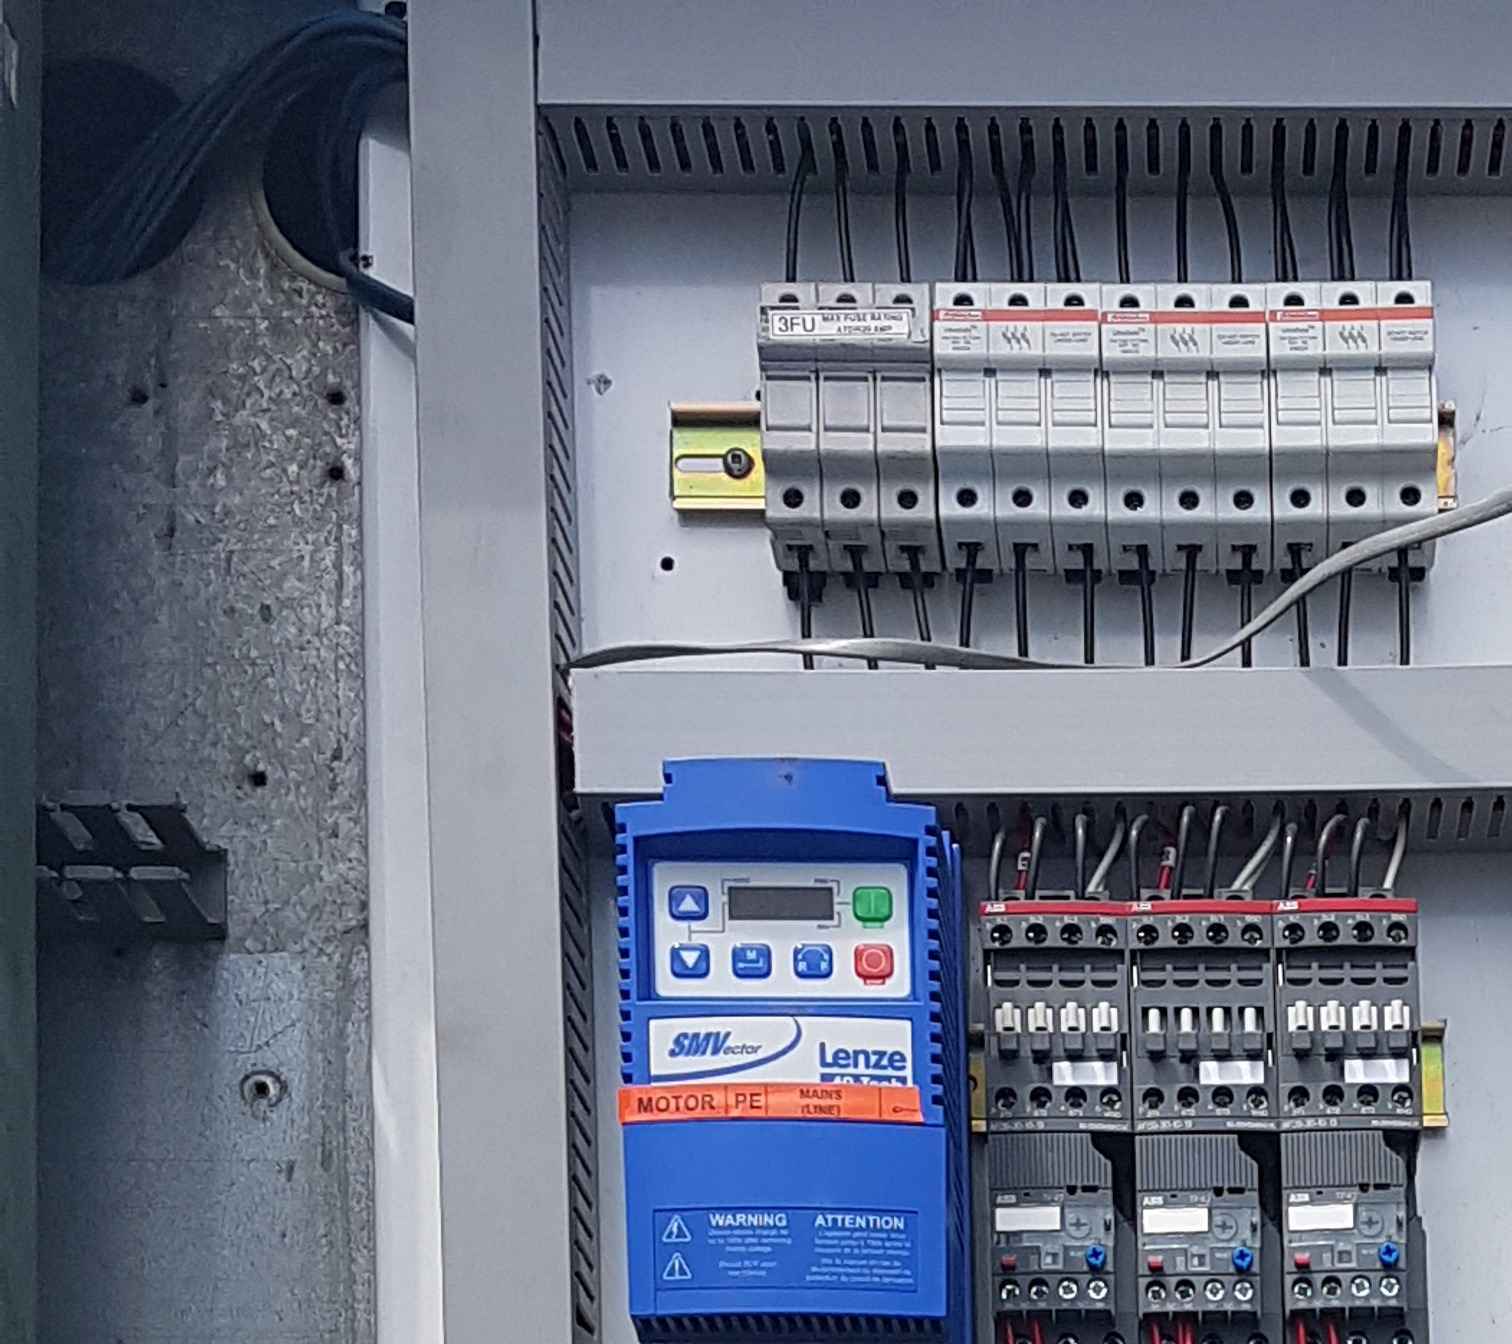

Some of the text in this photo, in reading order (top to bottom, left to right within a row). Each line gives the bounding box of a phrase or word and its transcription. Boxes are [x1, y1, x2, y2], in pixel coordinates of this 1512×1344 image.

[778, 316, 815, 332] 3FU
[848, 313, 868, 321] FUSE
[1278, 901, 1299, 909] ABB
[798, 963, 807, 972] R
[819, 1042, 907, 1071] Lenze
[800, 1089, 842, 1100] MAINS
[637, 1093, 762, 1113] MOTOR PE
[801, 1106, 840, 1116] (LINE)
[1143, 1196, 1163, 1206] ABB
[709, 1213, 788, 1227] WARNING
[814, 1215, 905, 1229] ATTENTION
